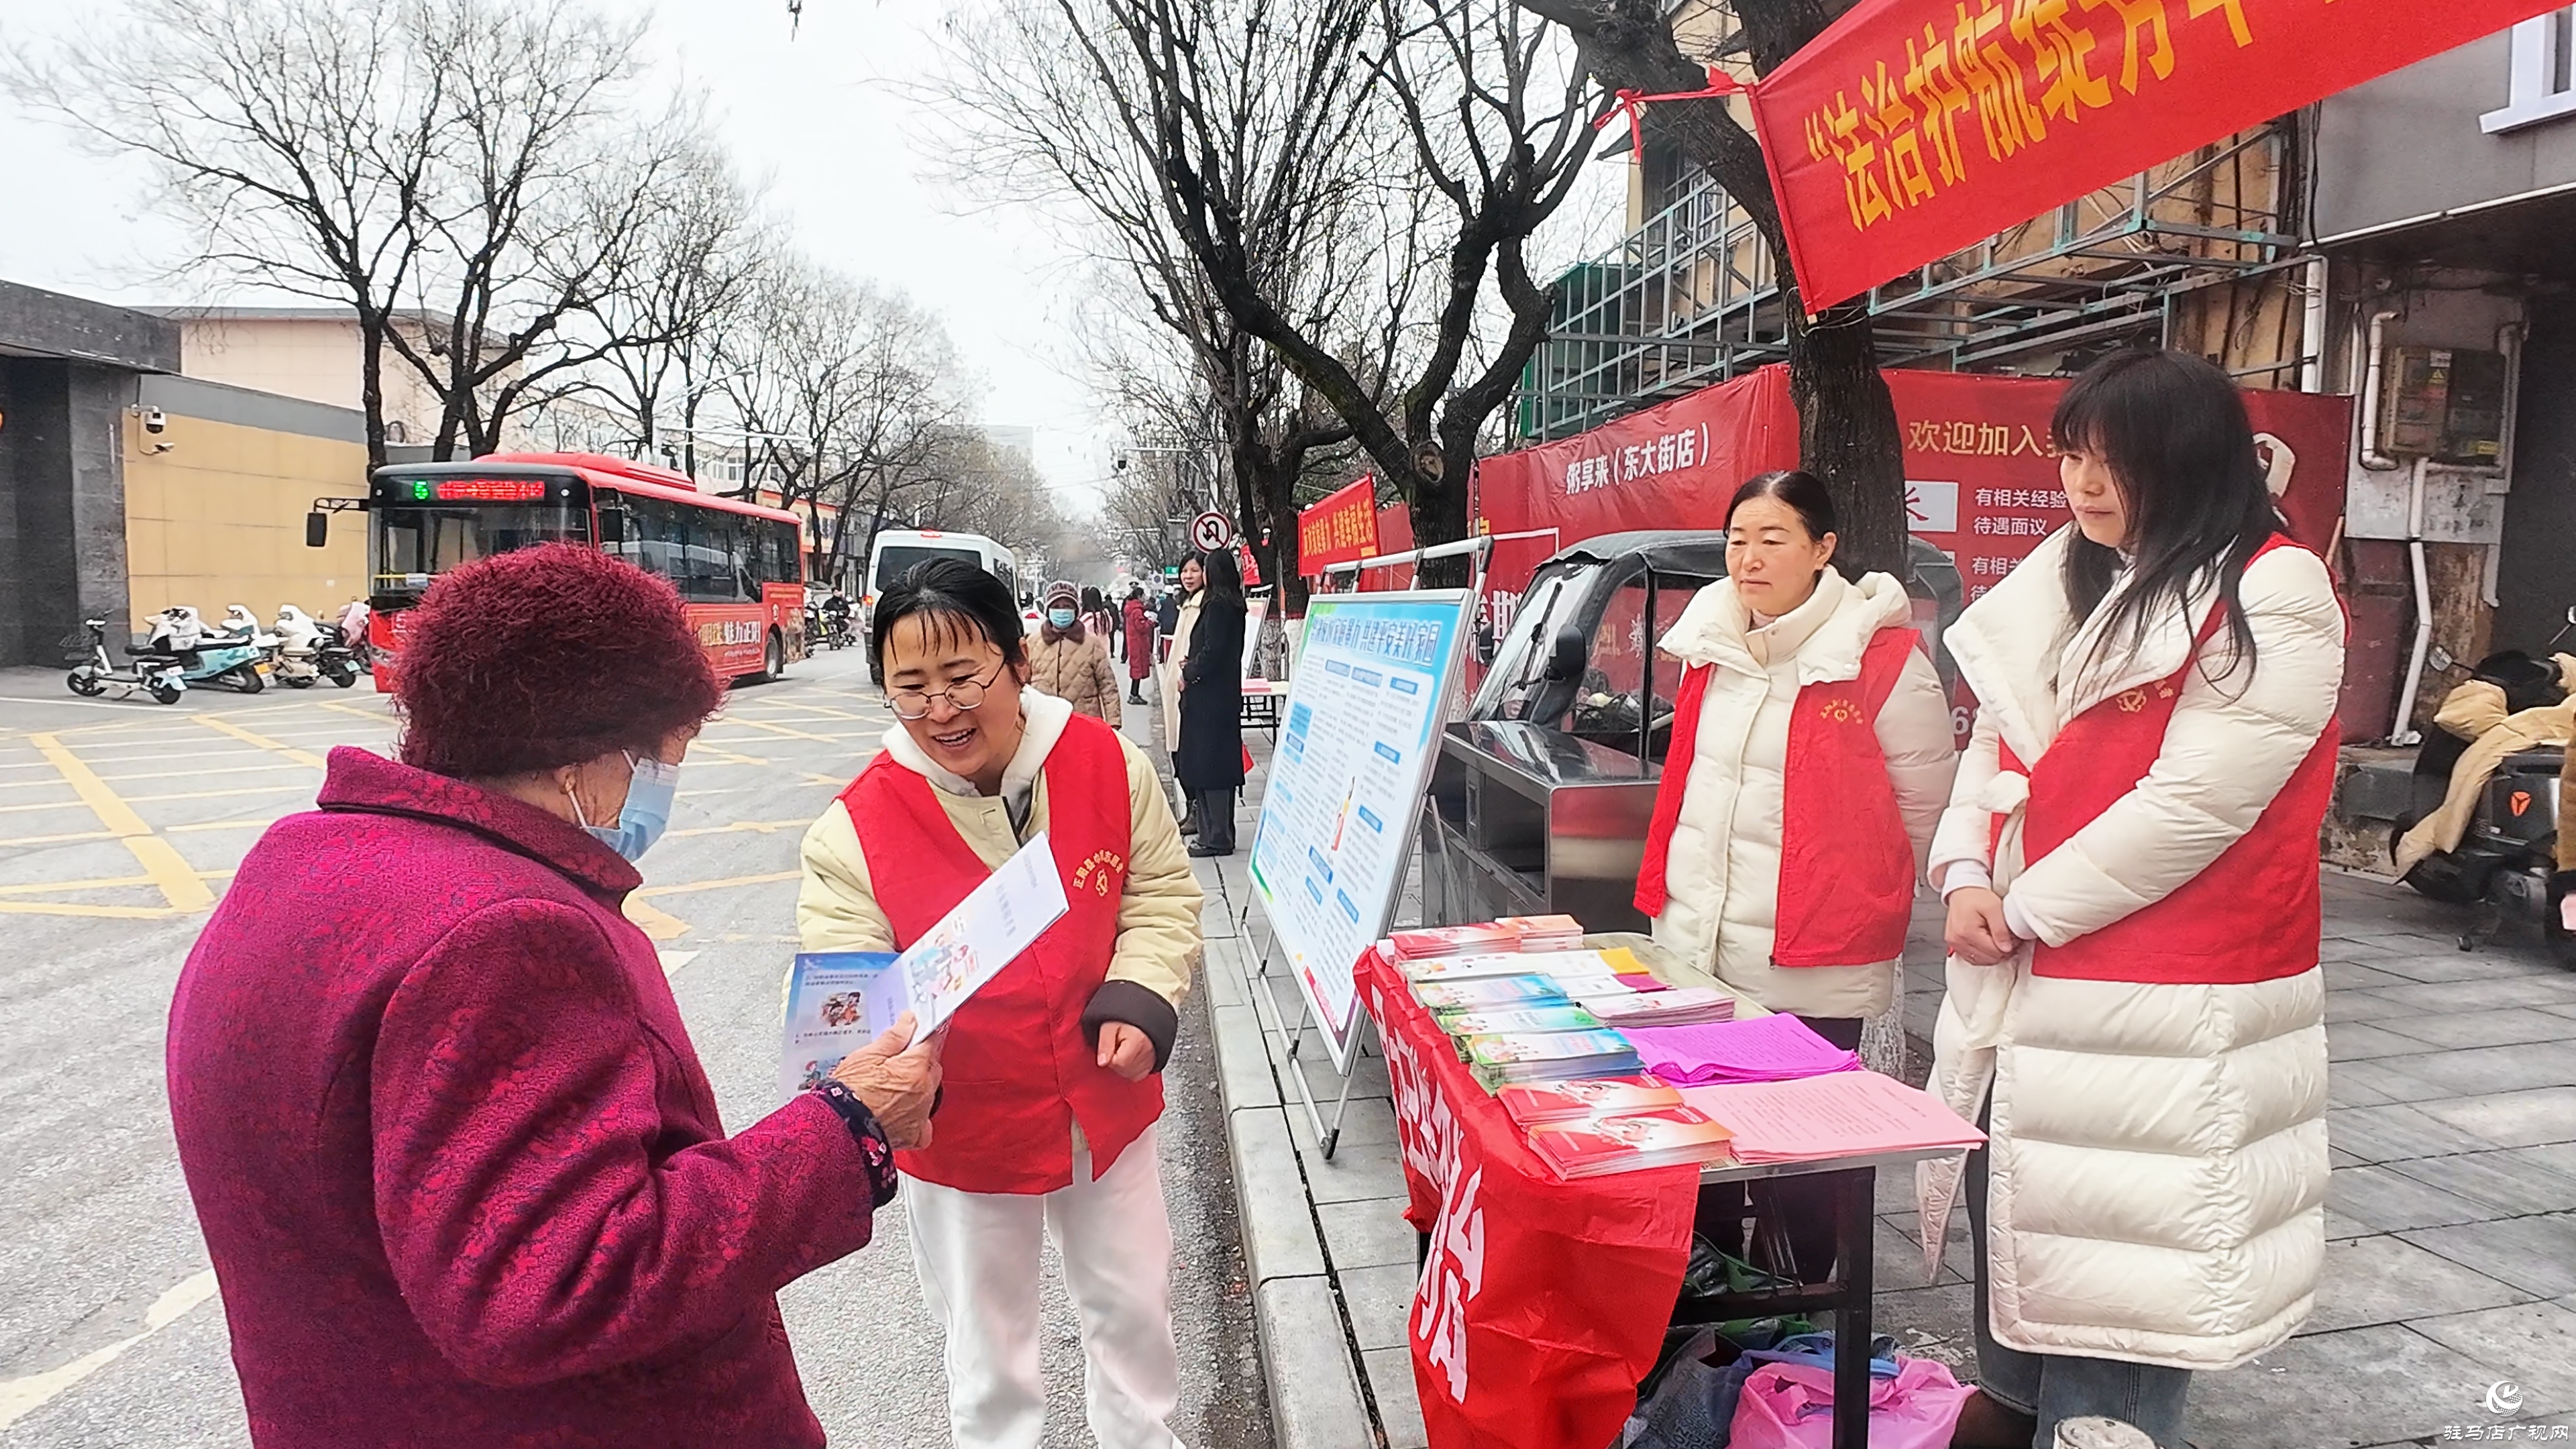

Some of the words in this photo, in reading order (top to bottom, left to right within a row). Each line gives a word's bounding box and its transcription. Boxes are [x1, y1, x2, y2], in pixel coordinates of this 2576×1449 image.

[1907, 419, 2063, 458] 欢迎加入
[1975, 488, 2069, 509] 有相关经验
[1974, 517, 2047, 537] 待遇面议
